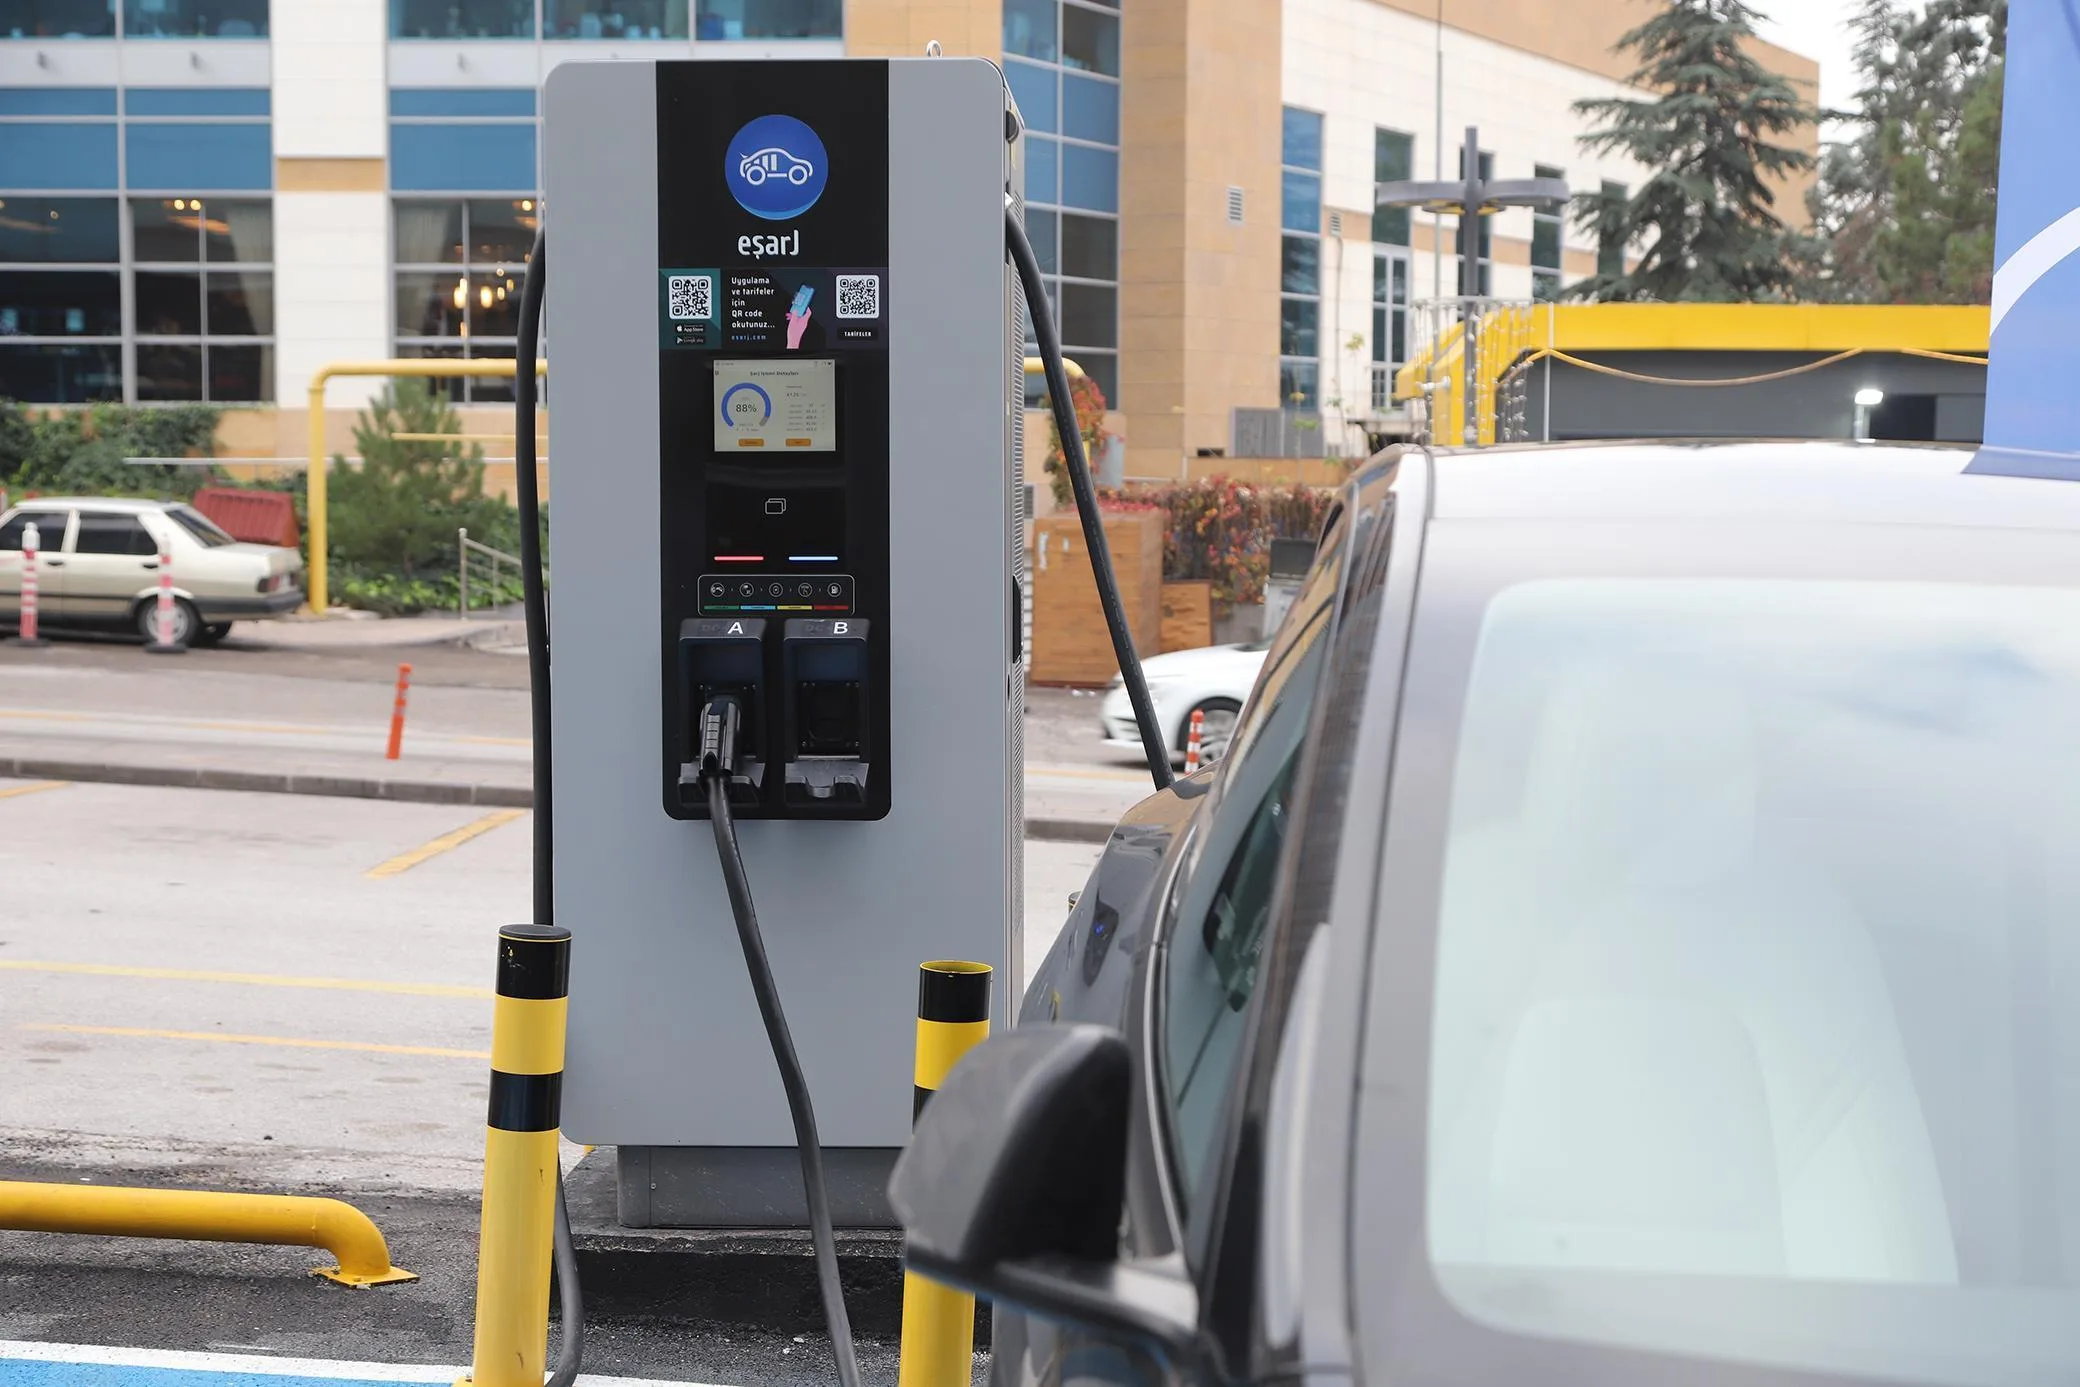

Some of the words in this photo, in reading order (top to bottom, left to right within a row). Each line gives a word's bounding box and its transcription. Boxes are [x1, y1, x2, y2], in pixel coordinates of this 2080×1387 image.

[731, 277, 770, 285] Uygulama
[742, 288, 775, 296] tarifeler
[731, 299, 746, 307] için
[731, 309, 743, 317] QR
[744, 309, 763, 317] code
[735, 403, 757, 413] 88%
[727, 621, 744, 634] A
[833, 621, 849, 634] B
